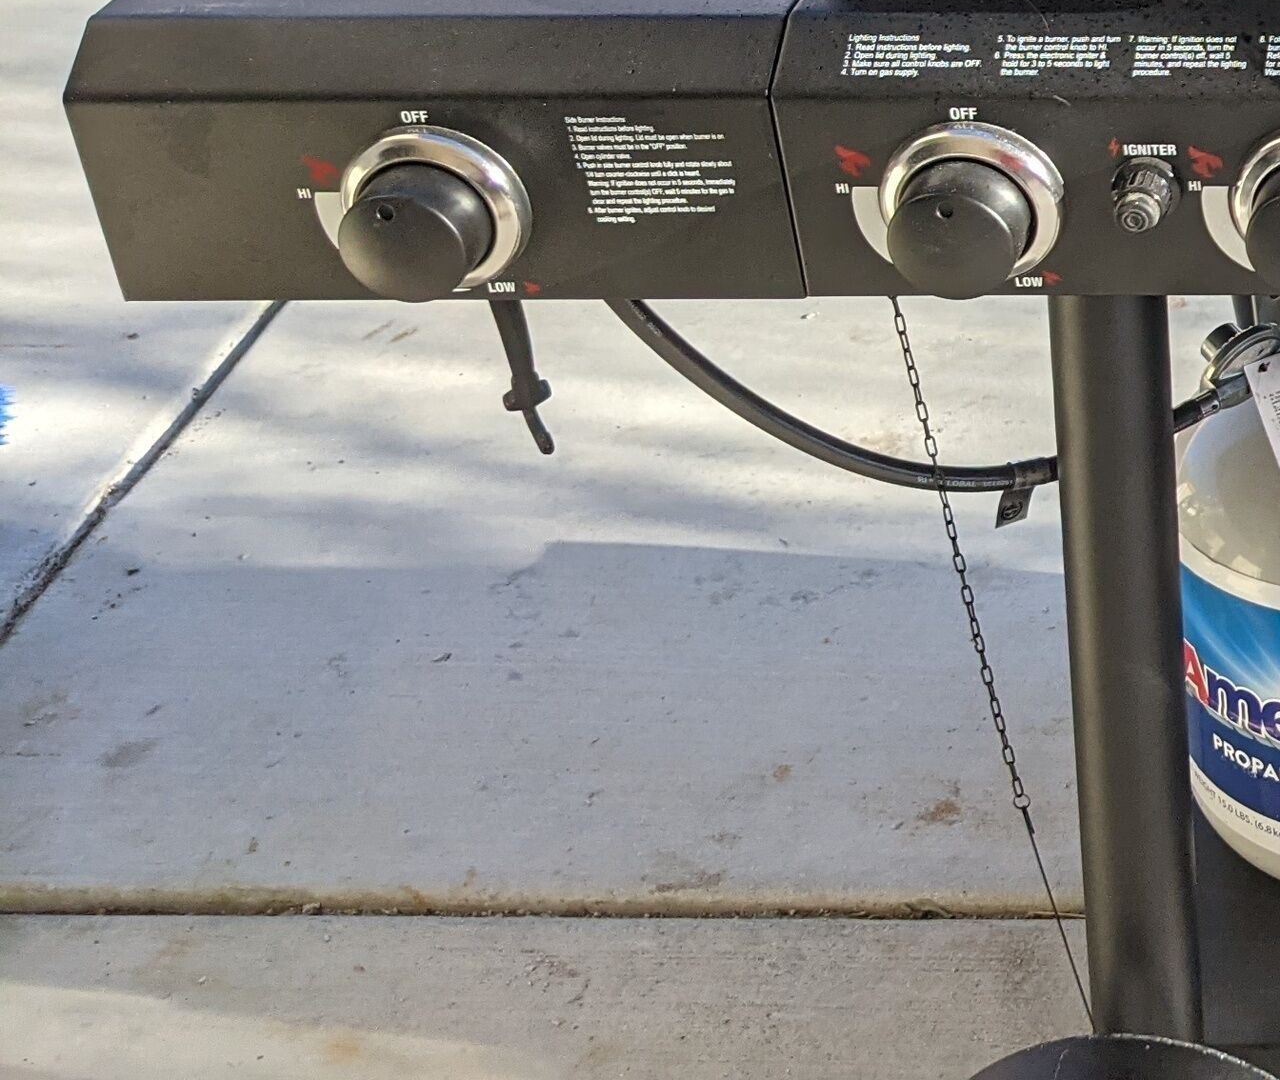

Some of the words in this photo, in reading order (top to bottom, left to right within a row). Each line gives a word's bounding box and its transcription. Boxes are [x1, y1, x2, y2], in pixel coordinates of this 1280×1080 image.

[943, 44, 971, 52] lighting.
[854, 52, 874, 60] Open
[886, 52, 908, 60] during
[910, 52, 938, 60] lighting.
[851, 68, 866, 76] Turn
[880, 70, 893, 78] gas
[894, 68, 920, 77] supply.
[400, 110, 429, 124] OFF
[949, 107, 977, 120] OFF
[1123, 144, 1177, 156] IGNITER
[836, 183, 849, 194] HI
[1188, 180, 1201, 192] HI
[297, 188, 312, 199] HI
[487, 282, 516, 293] LOW
[1015, 277, 1043, 288] LOW
